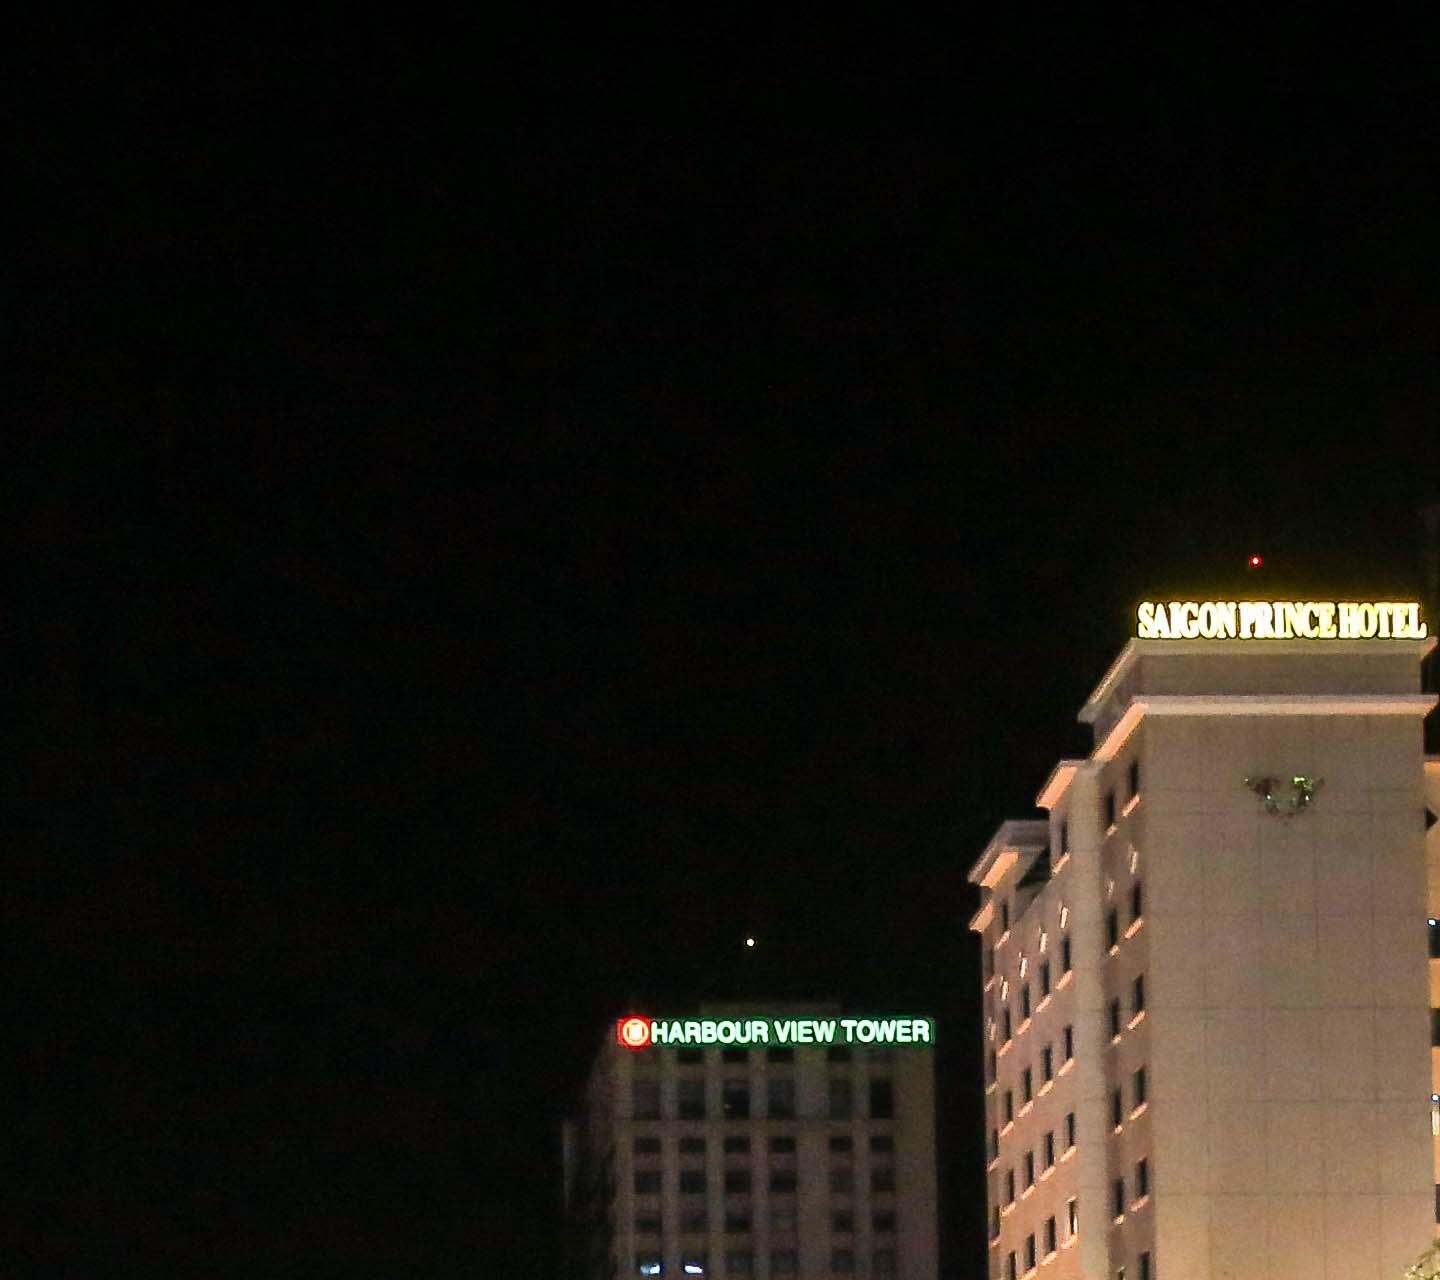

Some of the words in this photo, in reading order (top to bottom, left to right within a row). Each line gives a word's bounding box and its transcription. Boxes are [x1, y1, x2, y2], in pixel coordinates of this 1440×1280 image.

[1137, 601, 1237, 639] SAIGON
[1238, 601, 1337, 639] PRINCE
[1337, 602, 1427, 639] HOTEL
[650, 1018, 769, 1044] HARBOUR
[773, 1019, 836, 1043] VIEW
[840, 1019, 931, 1043] TOWER
